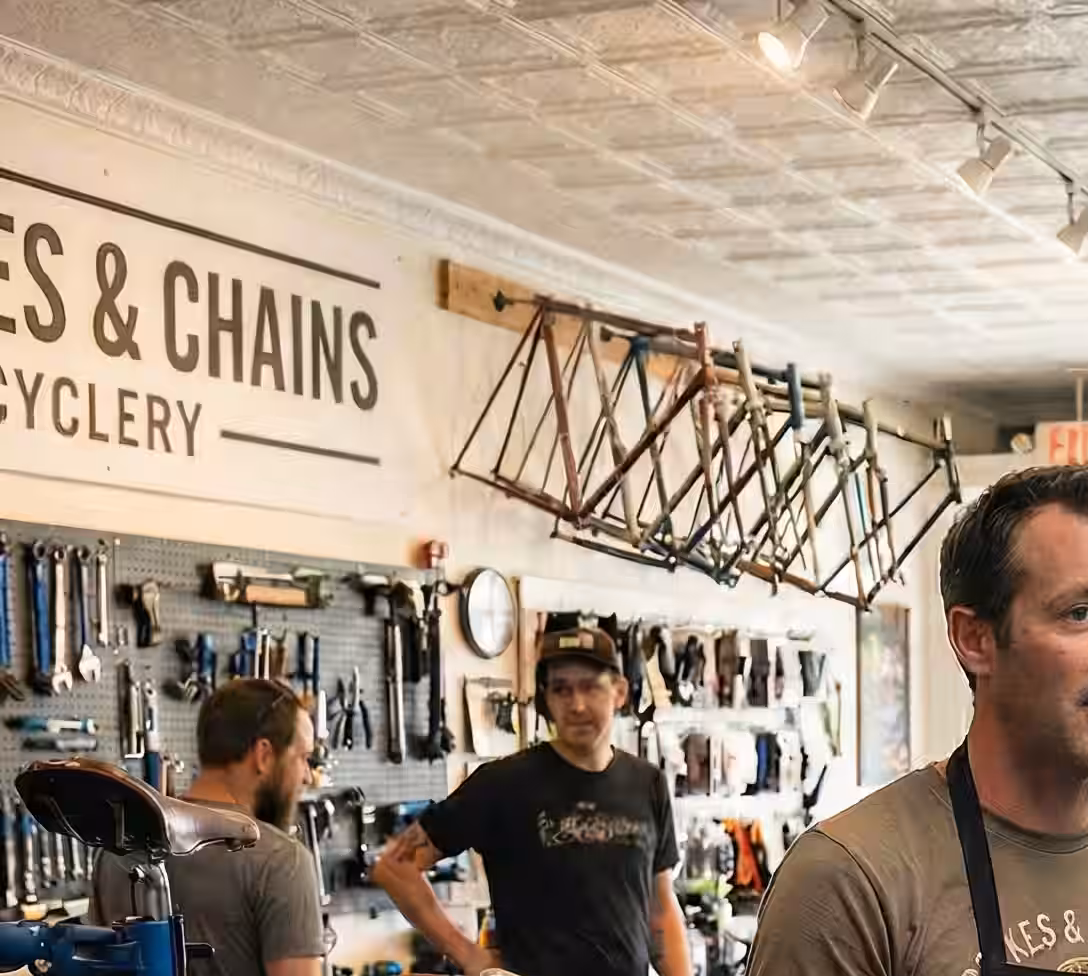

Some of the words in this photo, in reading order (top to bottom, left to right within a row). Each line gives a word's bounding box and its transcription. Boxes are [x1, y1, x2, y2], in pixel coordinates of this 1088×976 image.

[93, 242, 141, 360] &
[163, 261, 379, 411] CHAINS
[1063, 910, 1085, 944] &
